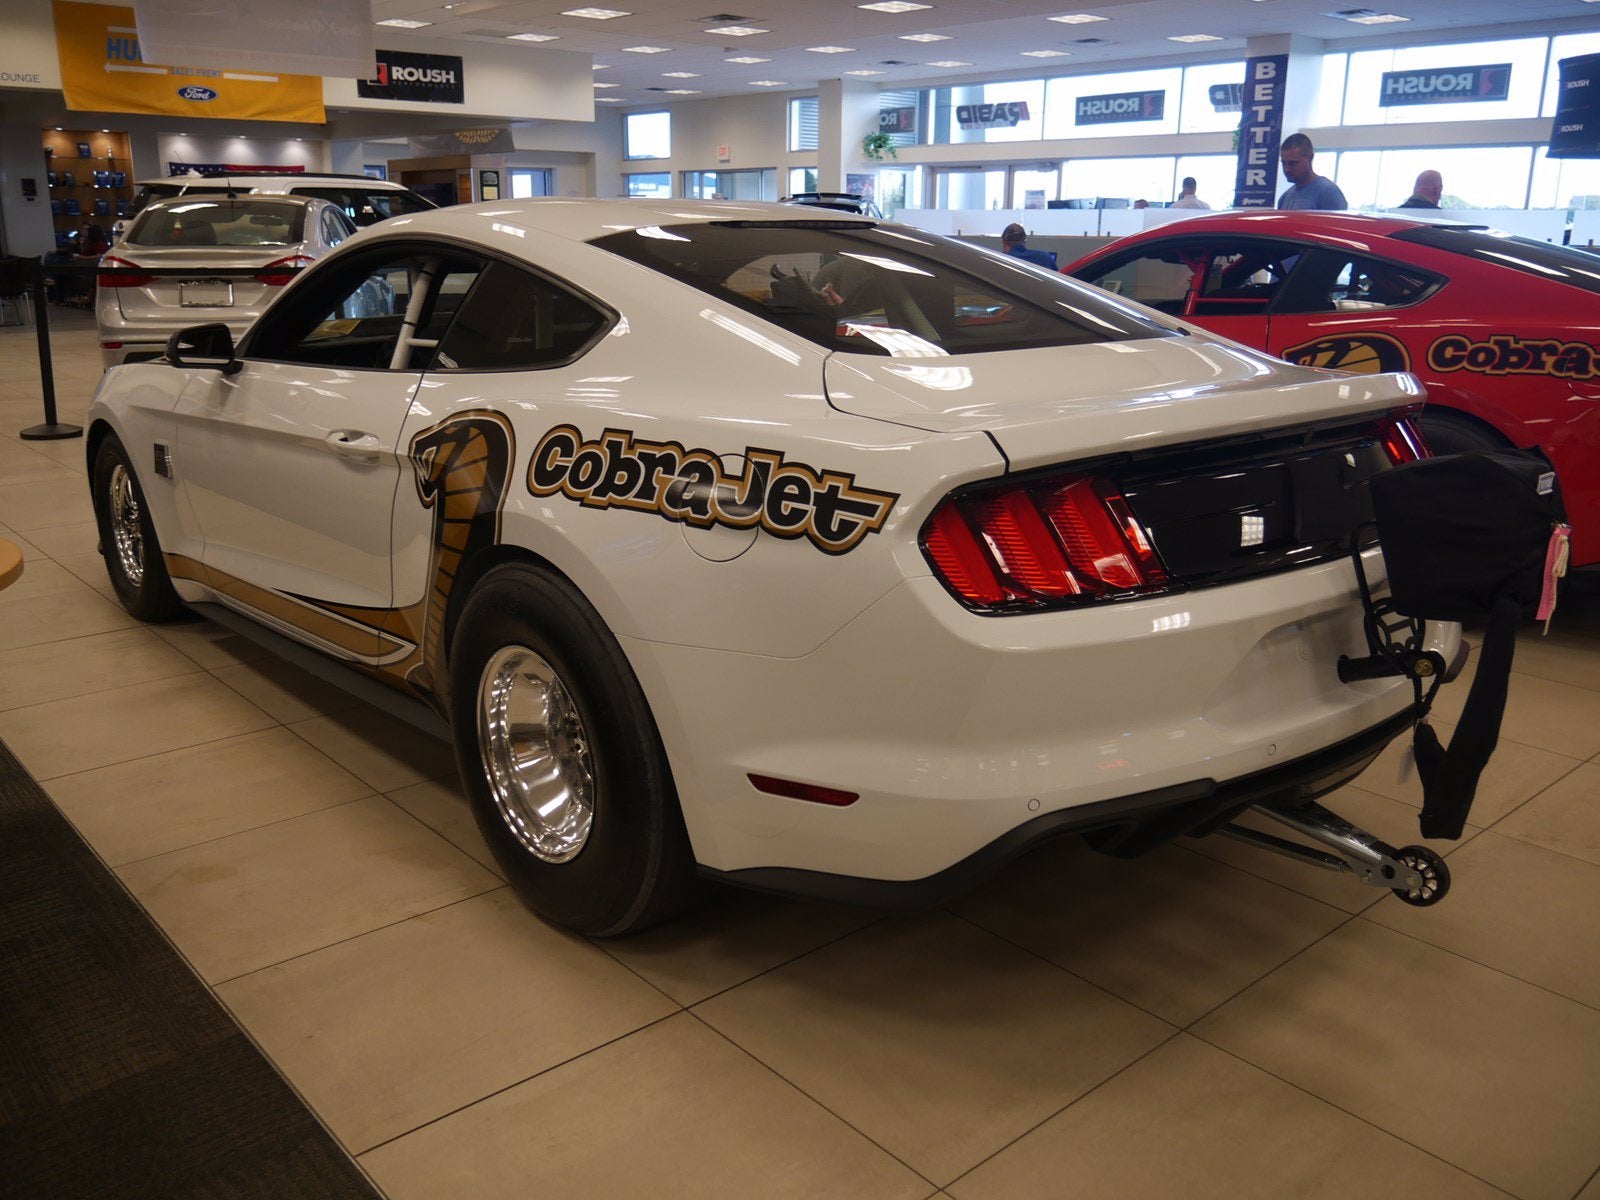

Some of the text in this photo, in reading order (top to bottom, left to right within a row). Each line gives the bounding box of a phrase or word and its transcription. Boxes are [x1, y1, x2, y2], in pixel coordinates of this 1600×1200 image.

[106, 37, 144, 62] HU
[0, 72, 40, 84] OUNGE
[170, 66, 222, 78] SALES EVENT
[391, 65, 455, 84] ROUSH
[184, 87, 211, 100] Ford
[1245, 61, 1277, 187] BETTER
